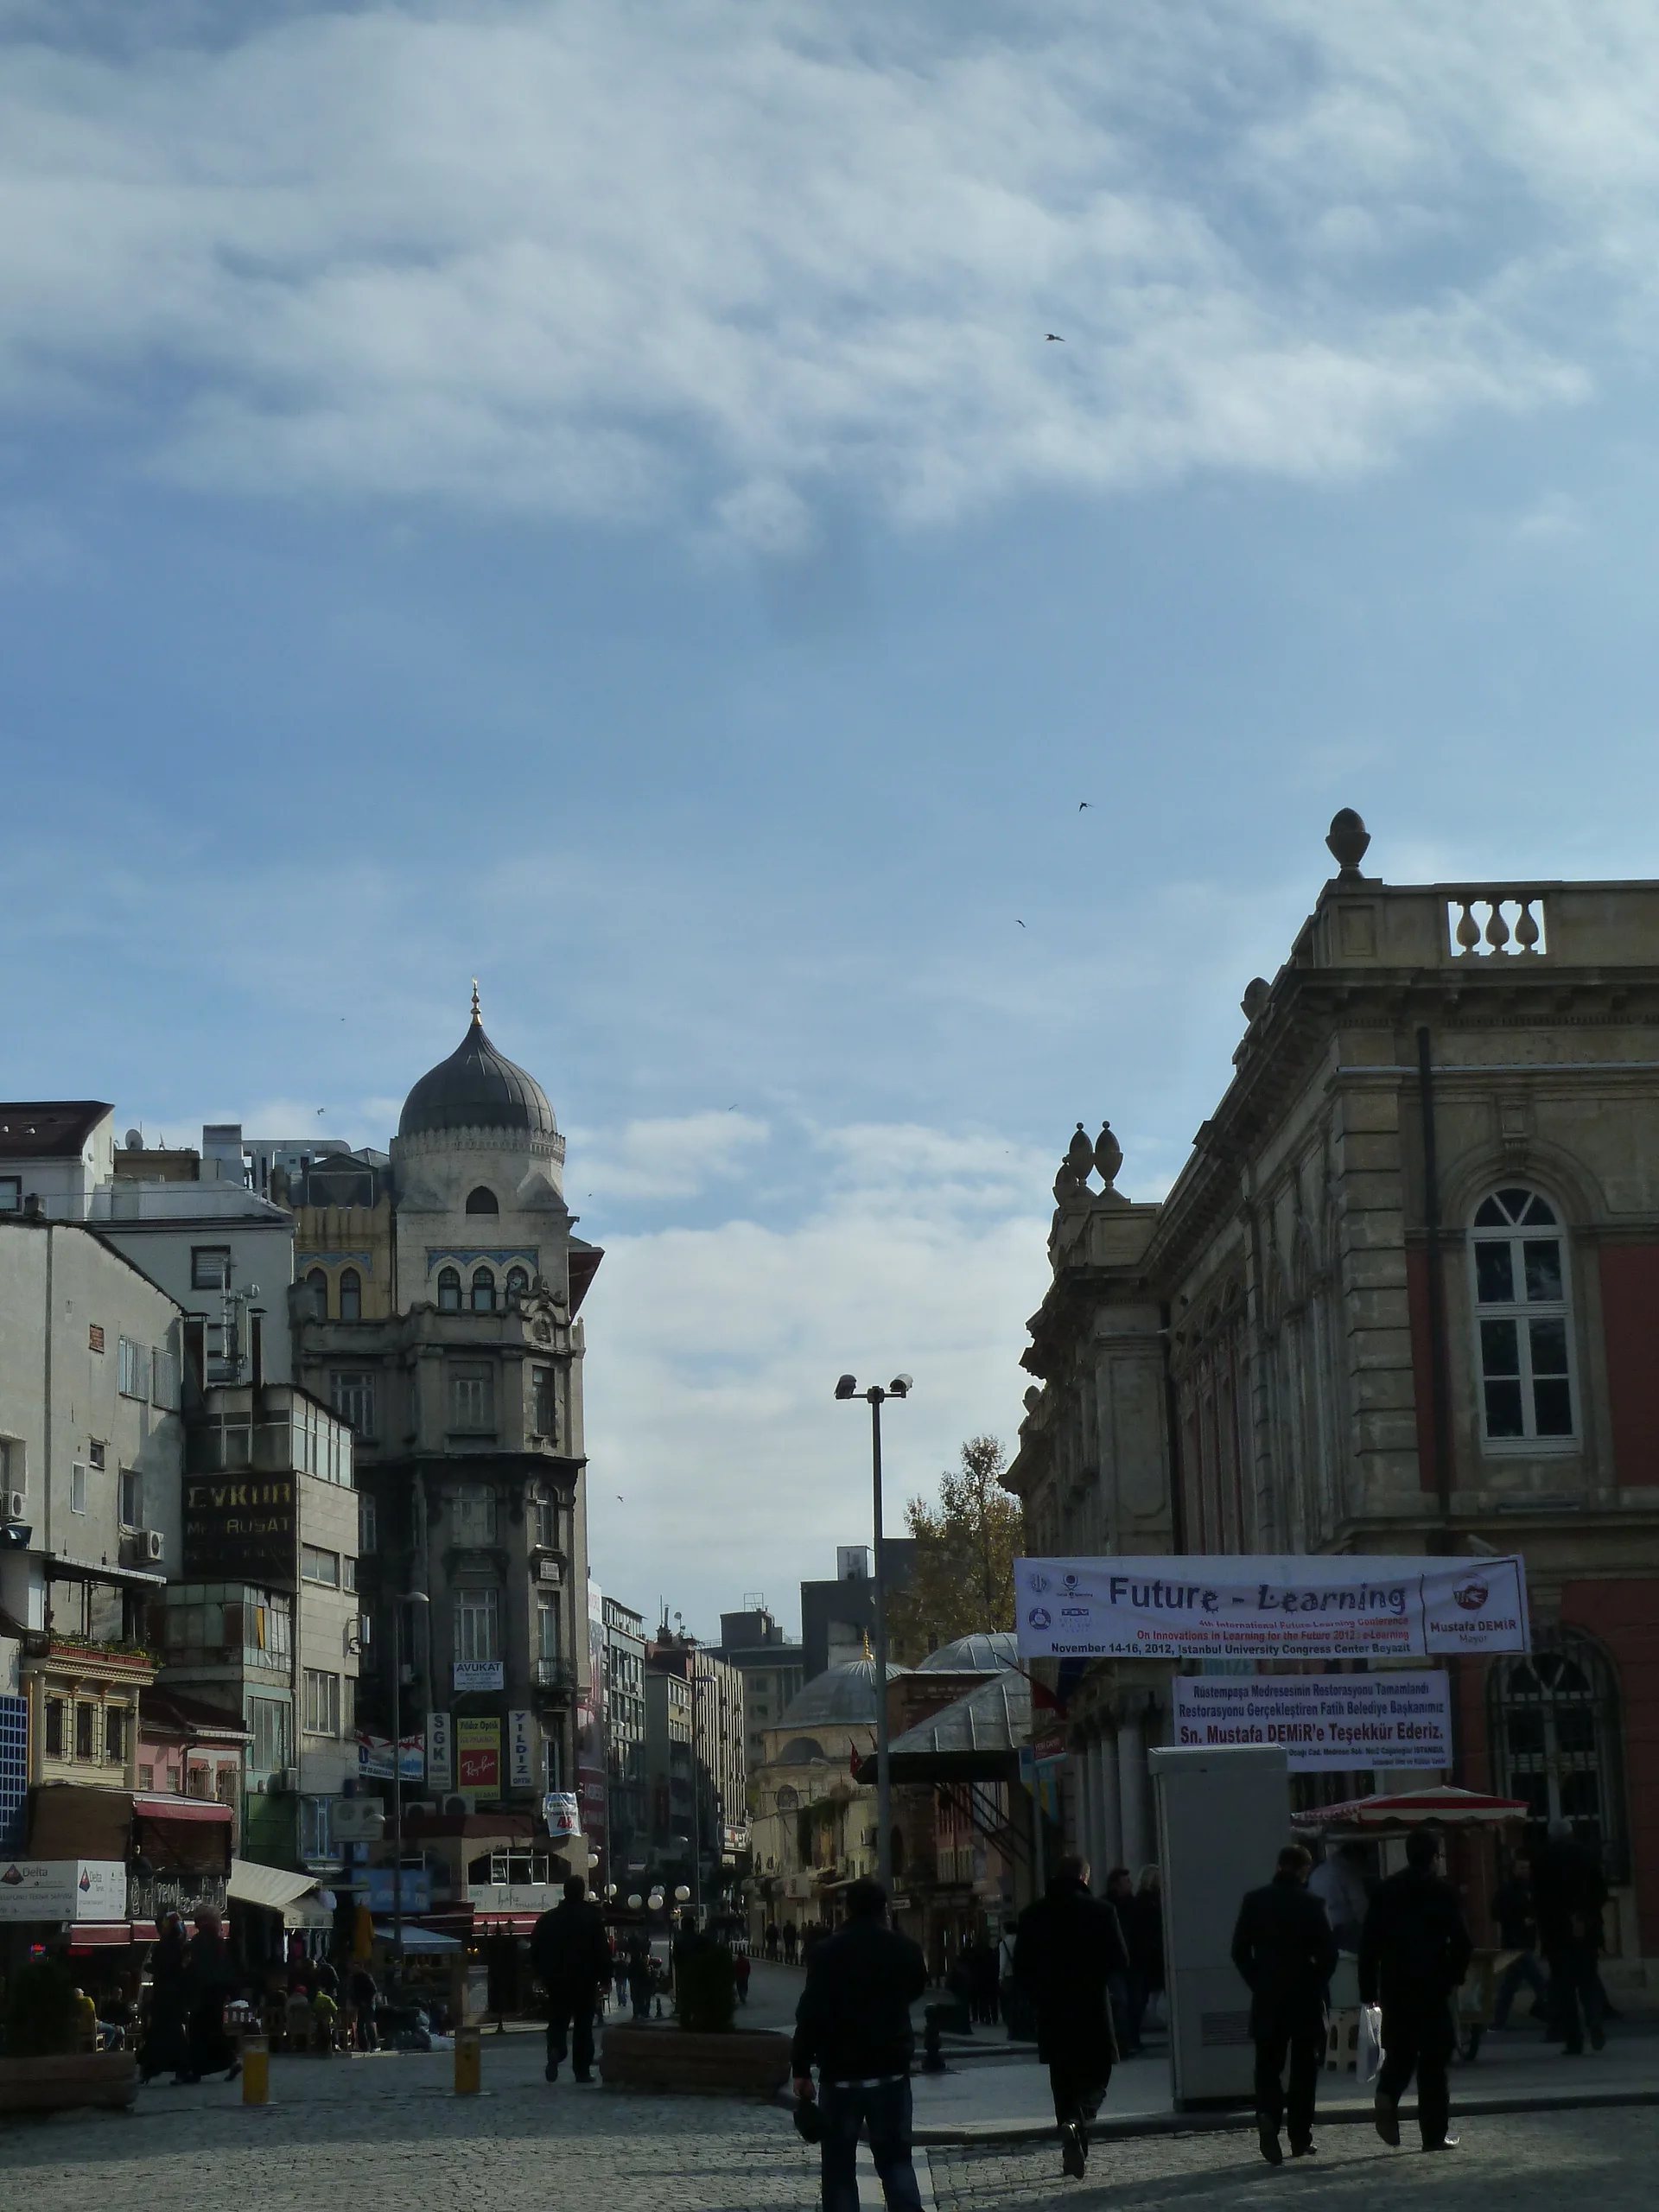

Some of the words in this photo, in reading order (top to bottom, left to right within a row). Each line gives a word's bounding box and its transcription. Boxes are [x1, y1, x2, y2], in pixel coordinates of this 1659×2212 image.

[1110, 1576, 1219, 1614] Future
[1258, 1582, 1406, 1615] Learning
[1216, 1621, 1277, 1630] International
[1357, 1616, 1408, 1627] Conference
[1430, 1620, 1476, 1632] Mustafa
[1137, 1630, 1150, 1640] On
[1153, 1630, 1208, 1641] Innovations
[1223, 1630, 1265, 1643] Learning
[1268, 1630, 1280, 1640] for
[1283, 1630, 1298, 1640] the
[1301, 1630, 1331, 1640] Future
[1363, 1630, 1409, 1642] e-Learning
[1459, 1635, 1487, 1646] Mayor
[1052, 1643, 1106, 1653] November
[1109, 1643, 1141, 1655] 14-16,
[1144, 1644, 1174, 1656] 2012,
[1178, 1643, 1222, 1654] Istanbul
[1224, 1643, 1279, 1656] University
[1282, 1643, 1332, 1656] Congress
[1334, 1643, 1369, 1654] Center
[1372, 1643, 1411, 1654] Beyazit
[456, 1662, 501, 1672] AVUKAT
[1193, 1685, 1249, 1700] Rüstempaşa
[1251, 1685, 1311, 1698] Medresesinin
[1313, 1683, 1373, 1699] Restorasyonu
[1376, 1682, 1429, 1695] Tamamlandı
[1179, 1704, 1244, 1719] Restorasyonu
[1247, 1702, 1318, 1719] Gerçekleştiren
[1320, 1701, 1344, 1716] Fatih
[1347, 1700, 1388, 1718] Belediye
[1390, 1700, 1444, 1717] Başkanımız
[480, 1719, 499, 1731] Optik
[433, 1714, 445, 1760] SGK
[1180, 1726, 1202, 1744] Sn.
[1207, 1724, 1262, 1744] Mustafa
[1328, 1722, 1394, 1745] Teşekkür
[1397, 1721, 1444, 1740] Ederiz.
[22, 1867, 48, 1877] Delta
